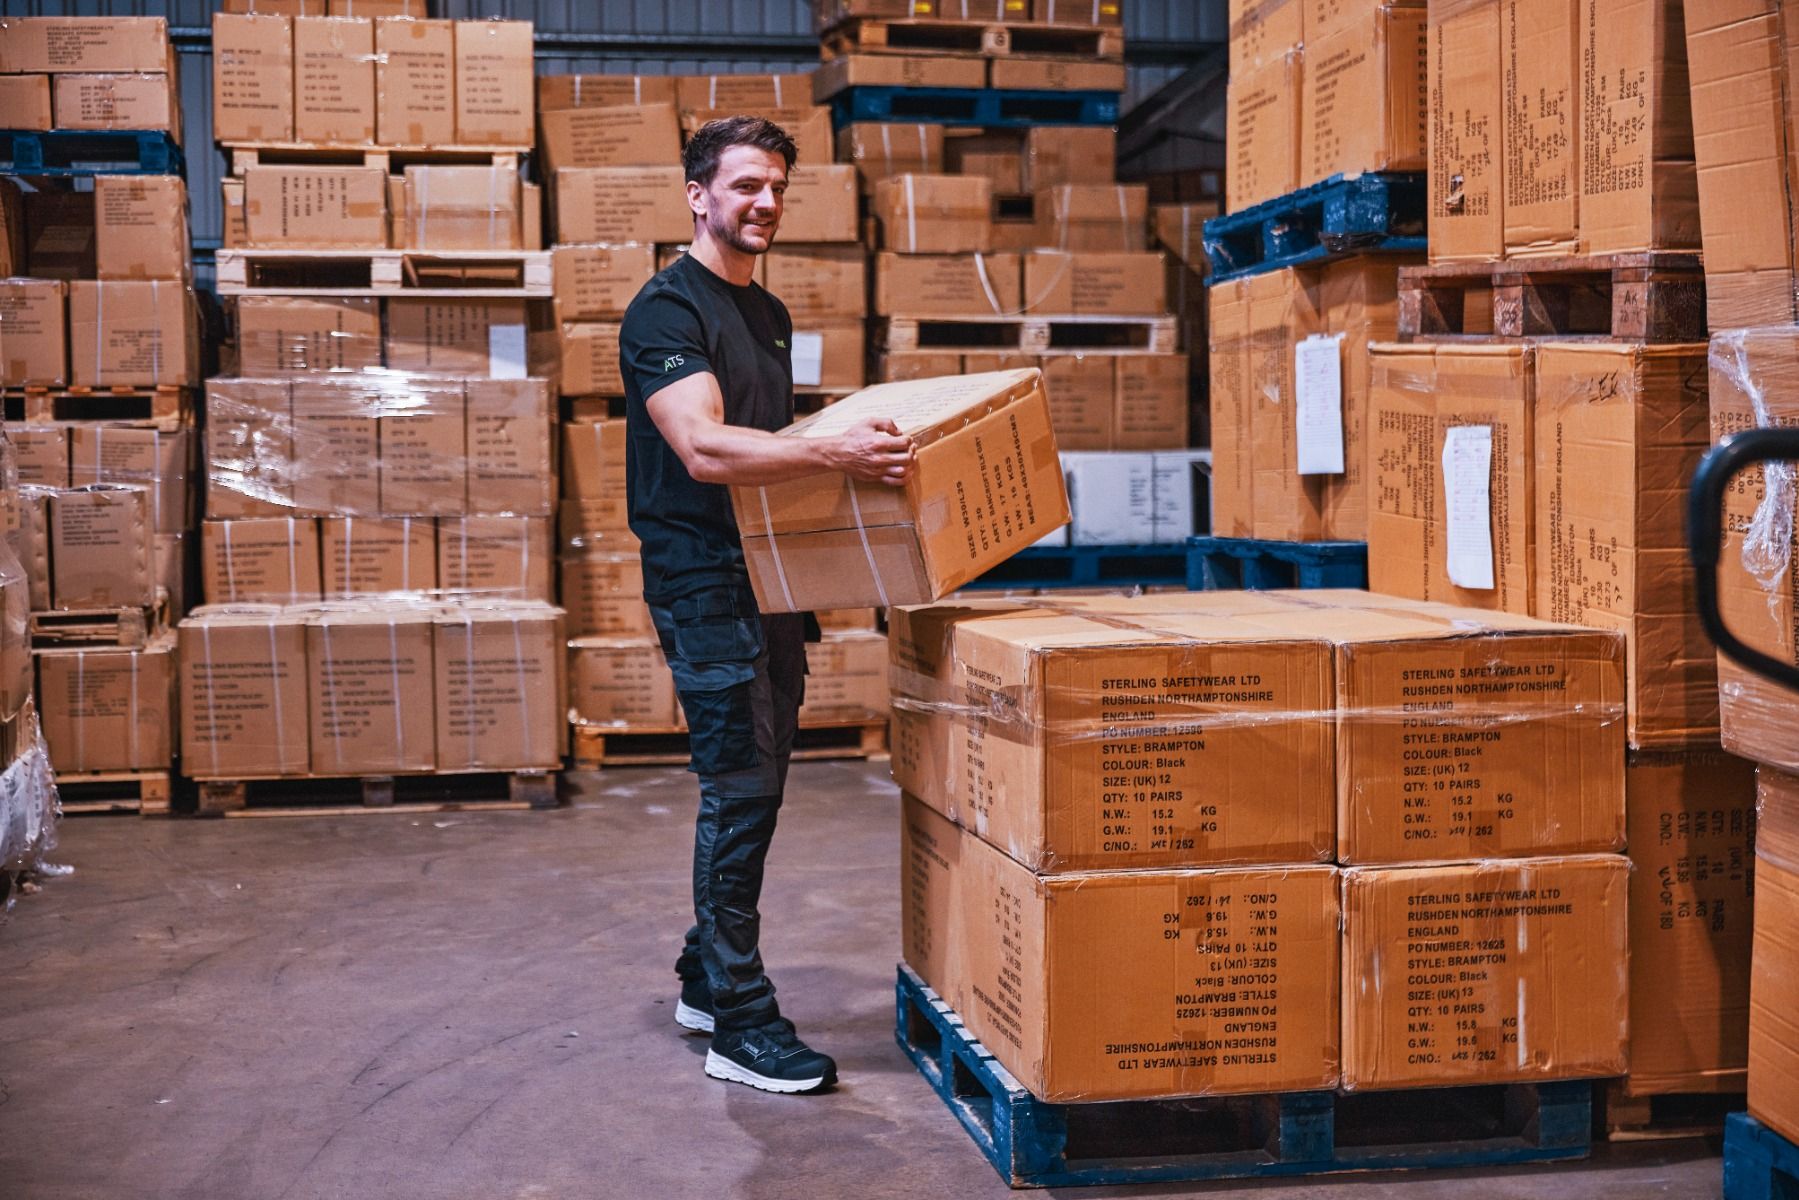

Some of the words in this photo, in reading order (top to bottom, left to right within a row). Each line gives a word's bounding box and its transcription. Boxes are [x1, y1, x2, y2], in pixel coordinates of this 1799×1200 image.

[665, 354, 685, 372] ATS
[1005, 457, 1014, 480] KGS
[992, 519, 1000, 543] ART:
[980, 525, 989, 550] QTY:
[968, 530, 976, 559] SIZE:
[1403, 669, 1454, 680] STERLING
[1536, 665, 1554, 675] LTD
[1102, 678, 1156, 689] STERLING
[1162, 676, 1235, 687] SAFETYWEAR
[1241, 676, 1260, 685] LTD
[1403, 685, 1453, 696] RUSHDEN
[1456, 679, 1566, 694] NORTHAMPTONSHIRE
[1102, 695, 1155, 706] RUSHDEN
[1158, 691, 1272, 704] NORTHAMPTONSHIRE
[1403, 701, 1453, 712] ENGLAND
[1102, 711, 1155, 722] ENGLAND
[1404, 734, 1439, 744] STYLE:
[1443, 732, 1500, 743] BRAMPTON
[1103, 744, 1140, 754] STYLE:
[1144, 741, 1204, 752] BRAMPTON
[1404, 749, 1451, 760] COLOUR:
[1455, 746, 1482, 756] Black
[1103, 760, 1152, 770] COLOUR:
[1157, 758, 1185, 767] Black
[1404, 766, 1430, 776] SIZE:
[1433, 765, 1454, 776] (UK)
[1458, 763, 1469, 772] 12
[1103, 777, 1130, 787] SIZE:
[1134, 776, 1156, 788] (UK)
[1160, 774, 1170, 783] 12
[1404, 782, 1427, 792] QTY:
[1433, 781, 1444, 790] 10
[1450, 779, 1480, 789] PAIRS
[1103, 793, 1127, 803] QTY:
[1134, 793, 1145, 802] 10
[1151, 791, 1182, 801] PAIRS
[1404, 798, 1429, 807] N.W.:
[1452, 796, 1472, 805] 15.2
[1498, 793, 1512, 803] KG
[1103, 810, 1129, 819] N.W.:
[1153, 809, 1173, 819] 15.2
[1201, 806, 1216, 815] KG
[1404, 814, 1430, 823] G.W.:
[1453, 811, 1472, 822] 19.1
[1498, 809, 1513, 819] KG
[1103, 826, 1130, 835] G.W.:
[1153, 826, 1173, 835] 19.1
[1201, 822, 1216, 832] KG
[1476, 826, 1492, 836] 262
[1176, 839, 1194, 849] 262
[1187, 896, 1205, 906] 262
[1408, 894, 1460, 905] STERLING
[1466, 890, 1536, 902] SAFETYWEAR
[1541, 889, 1560, 899] LTD
[1661, 891, 1672, 906] OF
[1250, 910, 1277, 920] G.W.:
[1408, 910, 1458, 921] RUSHDEN
[1461, 904, 1572, 918] NORTHAMPTONSHIRE
[1678, 902, 1689, 918] KG
[1164, 914, 1179, 923] KG
[1164, 930, 1179, 939] KG
[1207, 928, 1227, 938] 15.8
[1251, 926, 1276, 936] N.W.:
[1408, 926, 1459, 937] ENGLAND
[1197, 941, 1230, 954] PAIRS
[1236, 944, 1246, 952] 10
[1253, 942, 1277, 952] QTY:
[1425, 941, 1473, 952] NUMBER:
[1477, 939, 1505, 950] 12625
[1211, 962, 1221, 971] 13
[1225, 957, 1247, 969] (UK)
[1250, 958, 1276, 968] SIZE:
[1408, 958, 1444, 969] STYLE:
[1448, 954, 1506, 966] BRAMPTON
[1196, 977, 1224, 987] Black
[1228, 974, 1276, 985] COLOUR:
[1408, 974, 1455, 985] COLOUR:
[1460, 971, 1487, 981] Black
[1176, 993, 1235, 1004] BRAMPTON
[1239, 990, 1276, 1000] STYLE:
[1408, 991, 1434, 1001] SIZE:
[1438, 989, 1459, 1001] (UK)
[1462, 987, 1473, 996] 13
[1177, 1008, 1206, 1018] 12625
[1210, 1007, 1259, 1017] NUMBER:
[1408, 1007, 1431, 1016] QTY:
[1438, 1005, 1448, 1015] 10
[1454, 1004, 1484, 1014] PAIRS
[1225, 1022, 1276, 1033] ENGLAND
[1409, 1022, 1434, 1032] N.W.:
[1457, 1020, 1478, 1032] 15.8
[1502, 1017, 1517, 1027] KG
[1225, 1038, 1276, 1048] RUSHDEN
[1408, 1038, 1434, 1048] G.W.:
[1502, 1033, 1517, 1044] KG
[1106, 1040, 1221, 1054] NORTHAMPTONSHIRE
[1223, 1053, 1276, 1065] STERLING
[1479, 1051, 1495, 1060] 262
[1119, 1060, 1138, 1069] LTD
[1144, 1056, 1217, 1068] SAFETYWEAR
